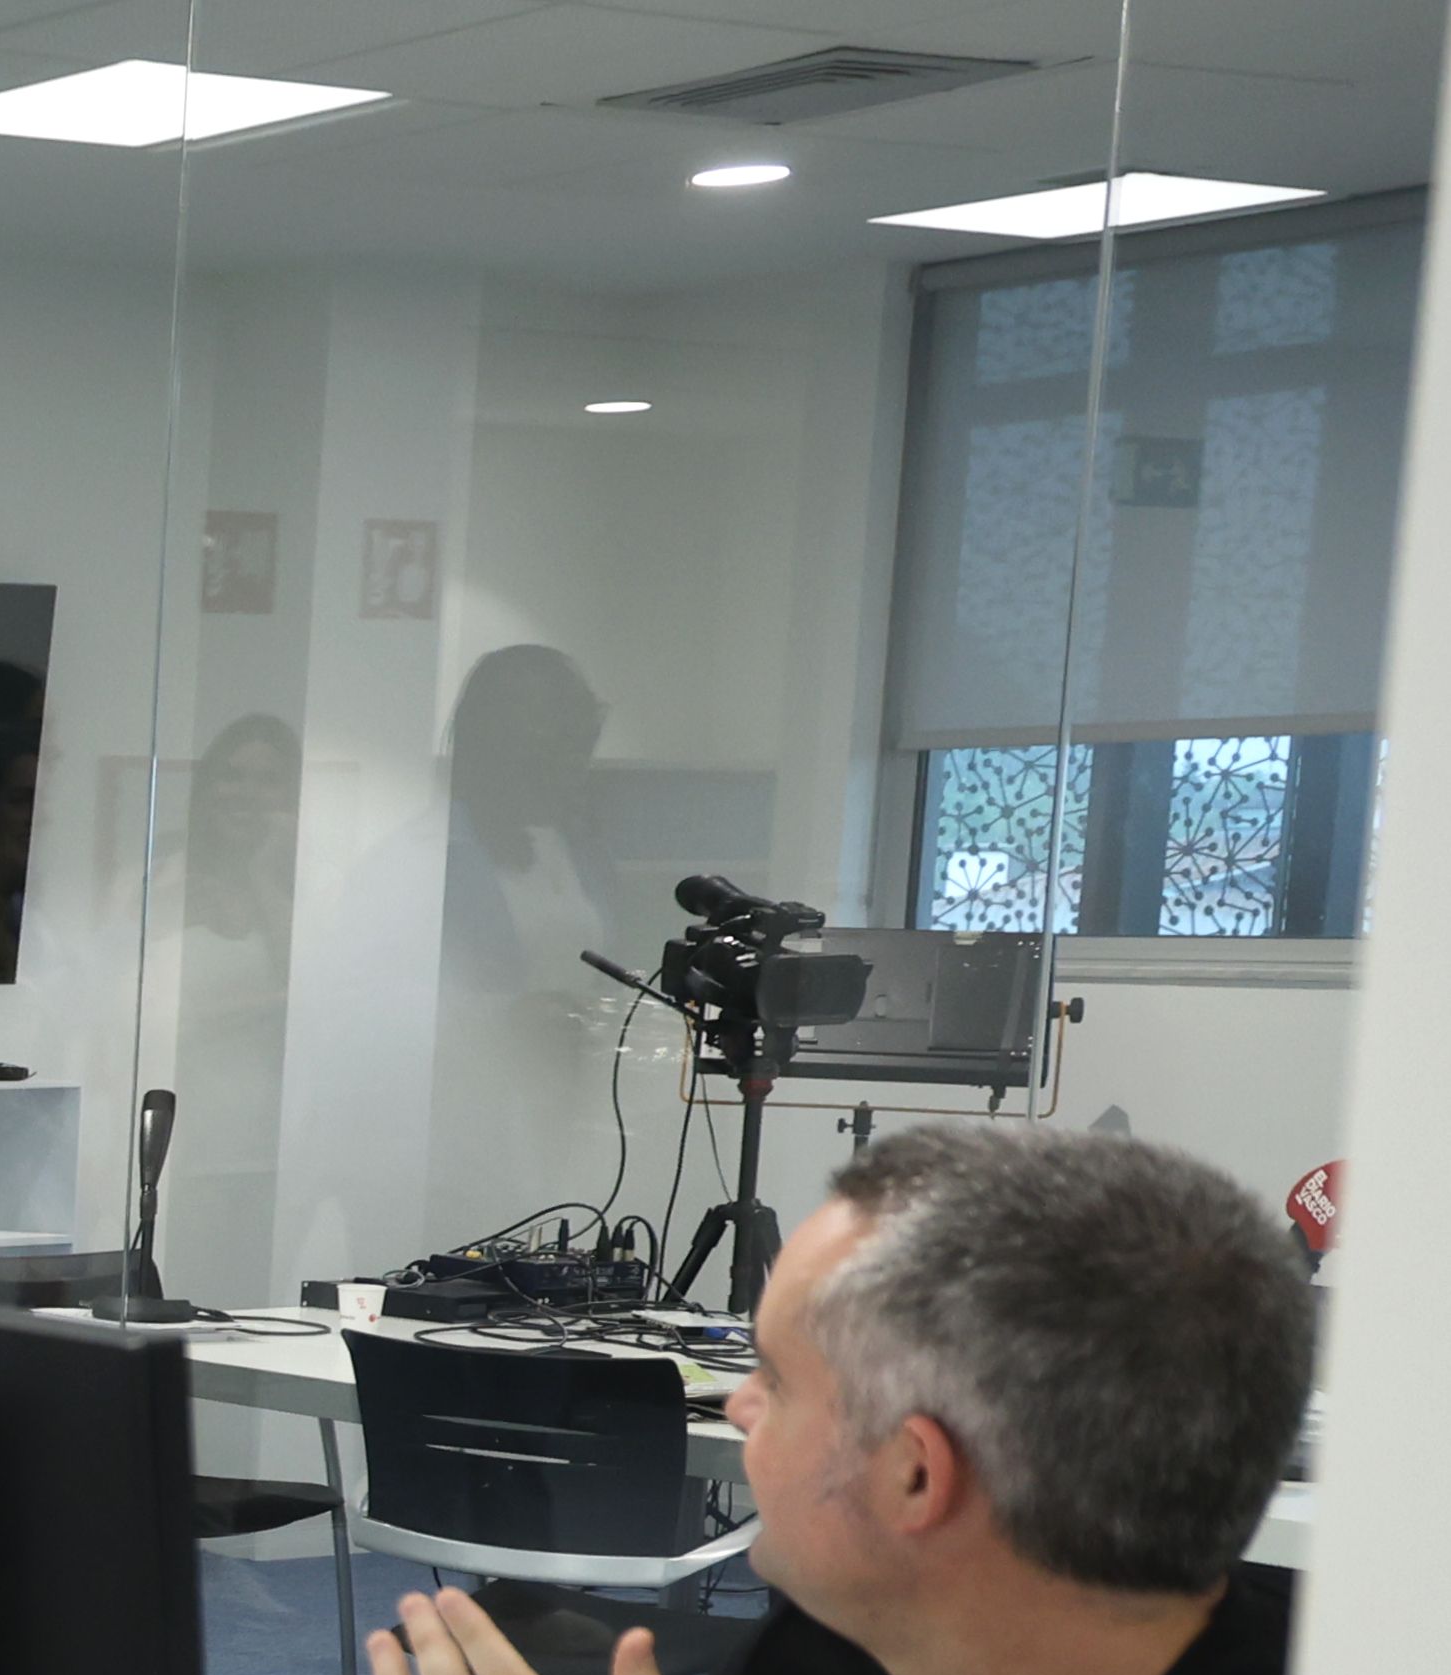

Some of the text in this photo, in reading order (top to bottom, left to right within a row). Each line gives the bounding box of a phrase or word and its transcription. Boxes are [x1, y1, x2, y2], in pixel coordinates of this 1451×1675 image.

[1313, 1169, 1329, 1188] EL
[1300, 1186, 1327, 1225] VASCO
[1305, 1179, 1336, 1218] DIARIO
